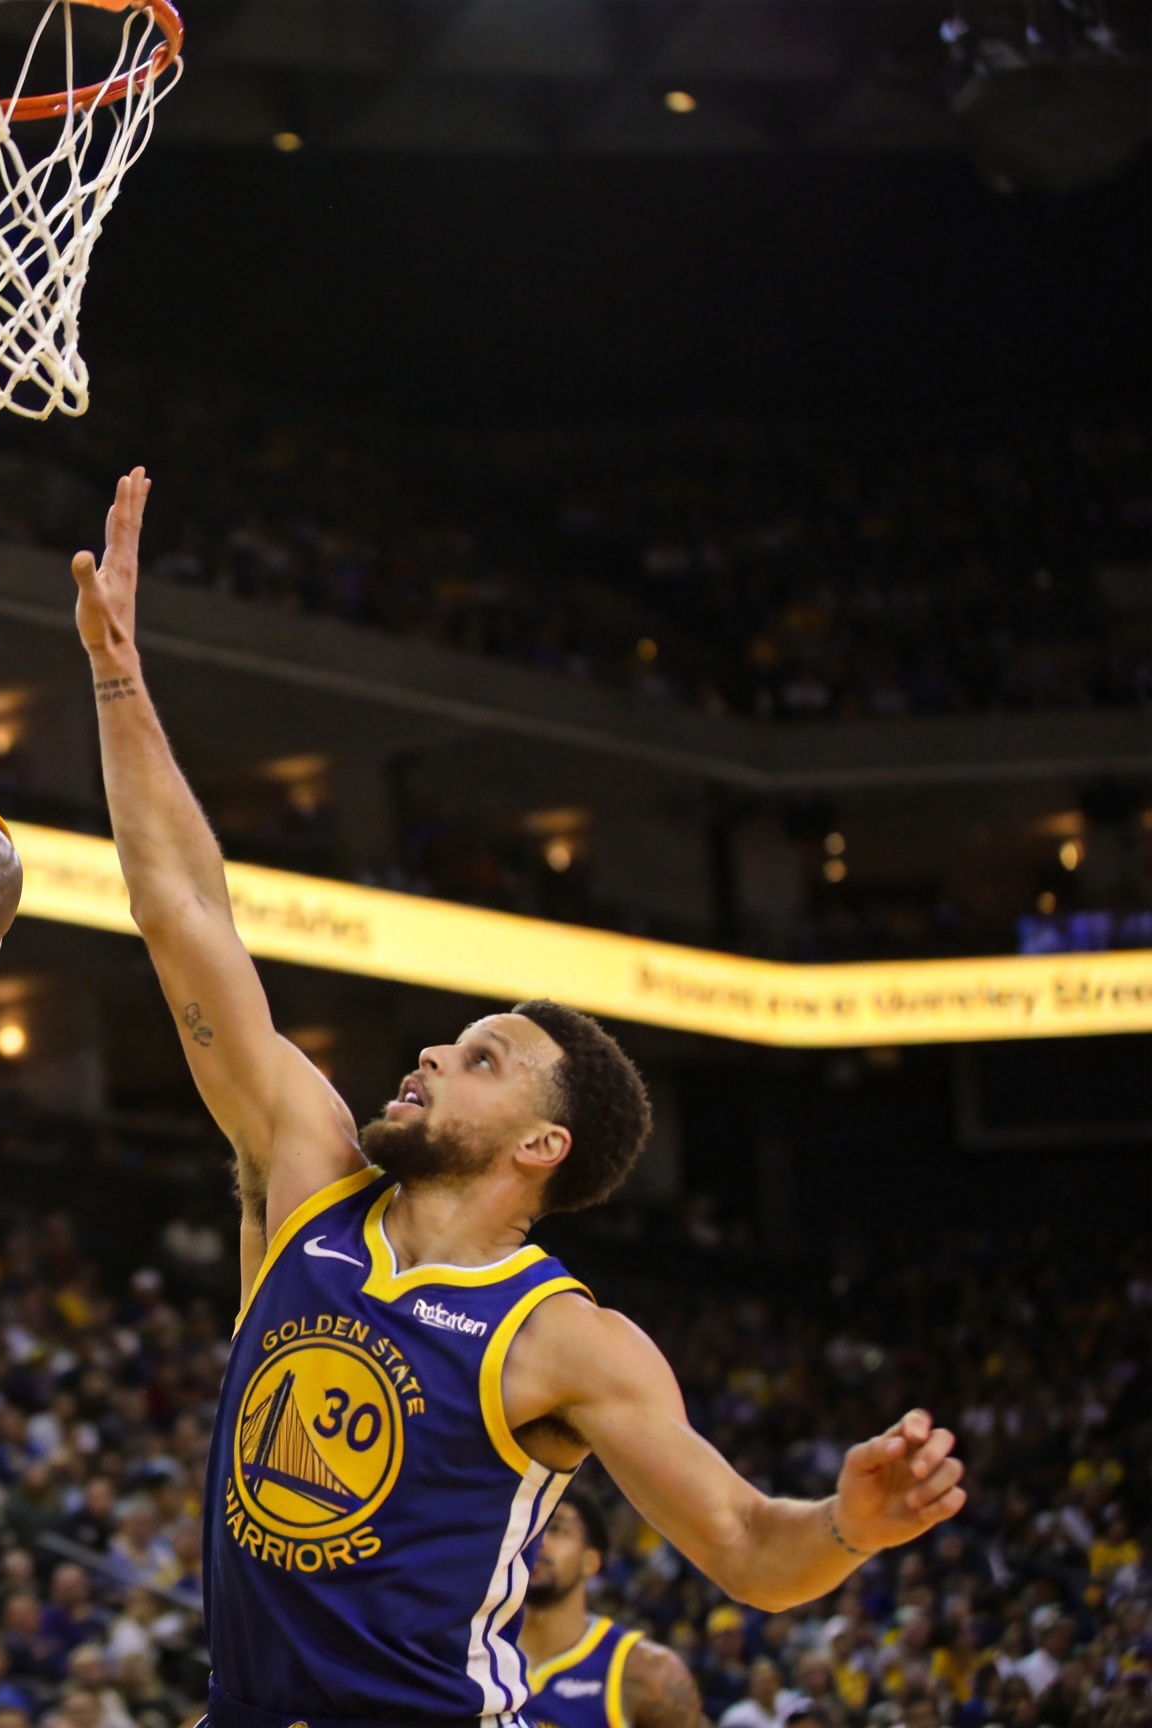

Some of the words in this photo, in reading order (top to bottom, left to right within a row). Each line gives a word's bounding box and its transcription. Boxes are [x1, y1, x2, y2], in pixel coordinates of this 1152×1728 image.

[262, 1314, 370, 1351] GOLDEN
[370, 1337, 426, 1417] STATE
[312, 1387, 382, 1452] 30
[225, 1477, 382, 1574] WARRIORS
